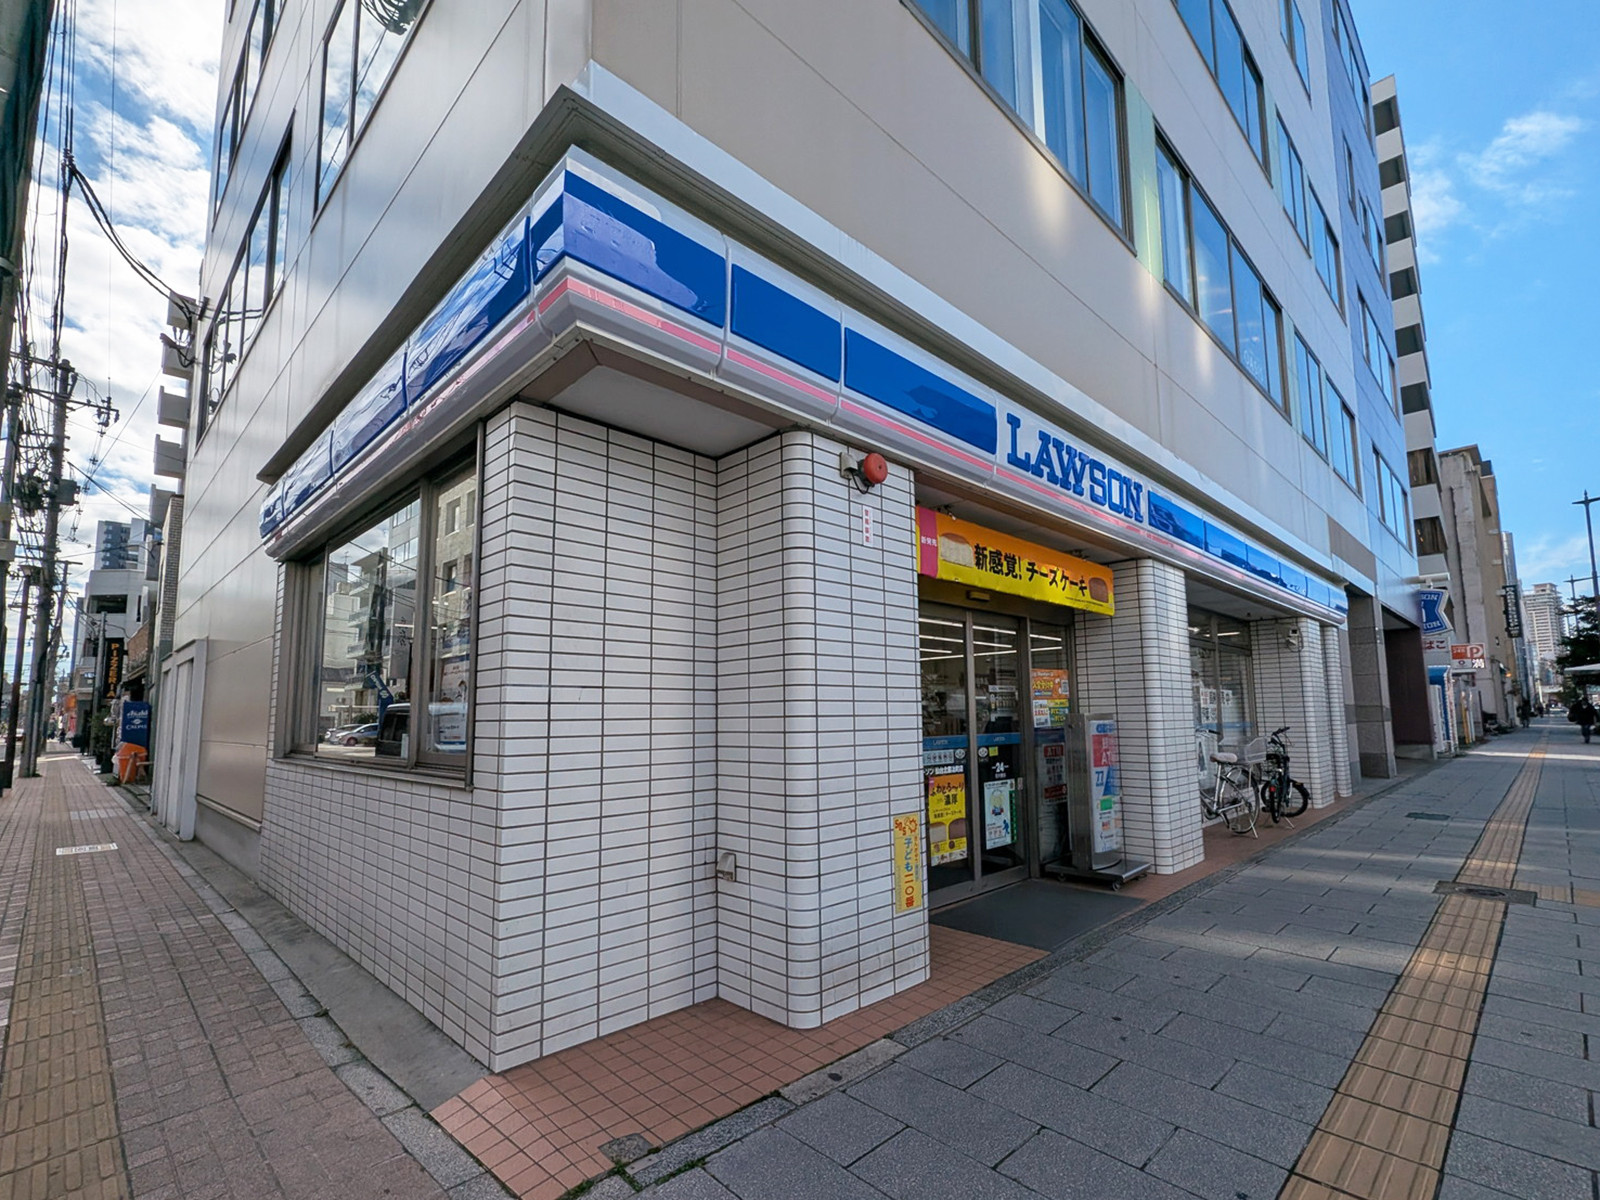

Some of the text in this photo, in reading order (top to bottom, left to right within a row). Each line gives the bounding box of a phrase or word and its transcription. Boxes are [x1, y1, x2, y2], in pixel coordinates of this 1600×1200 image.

[1007, 412, 1144, 524] LAWSON
[107, 643, 120, 698] PIZZERIA
[1467, 645, 1484, 659] P
